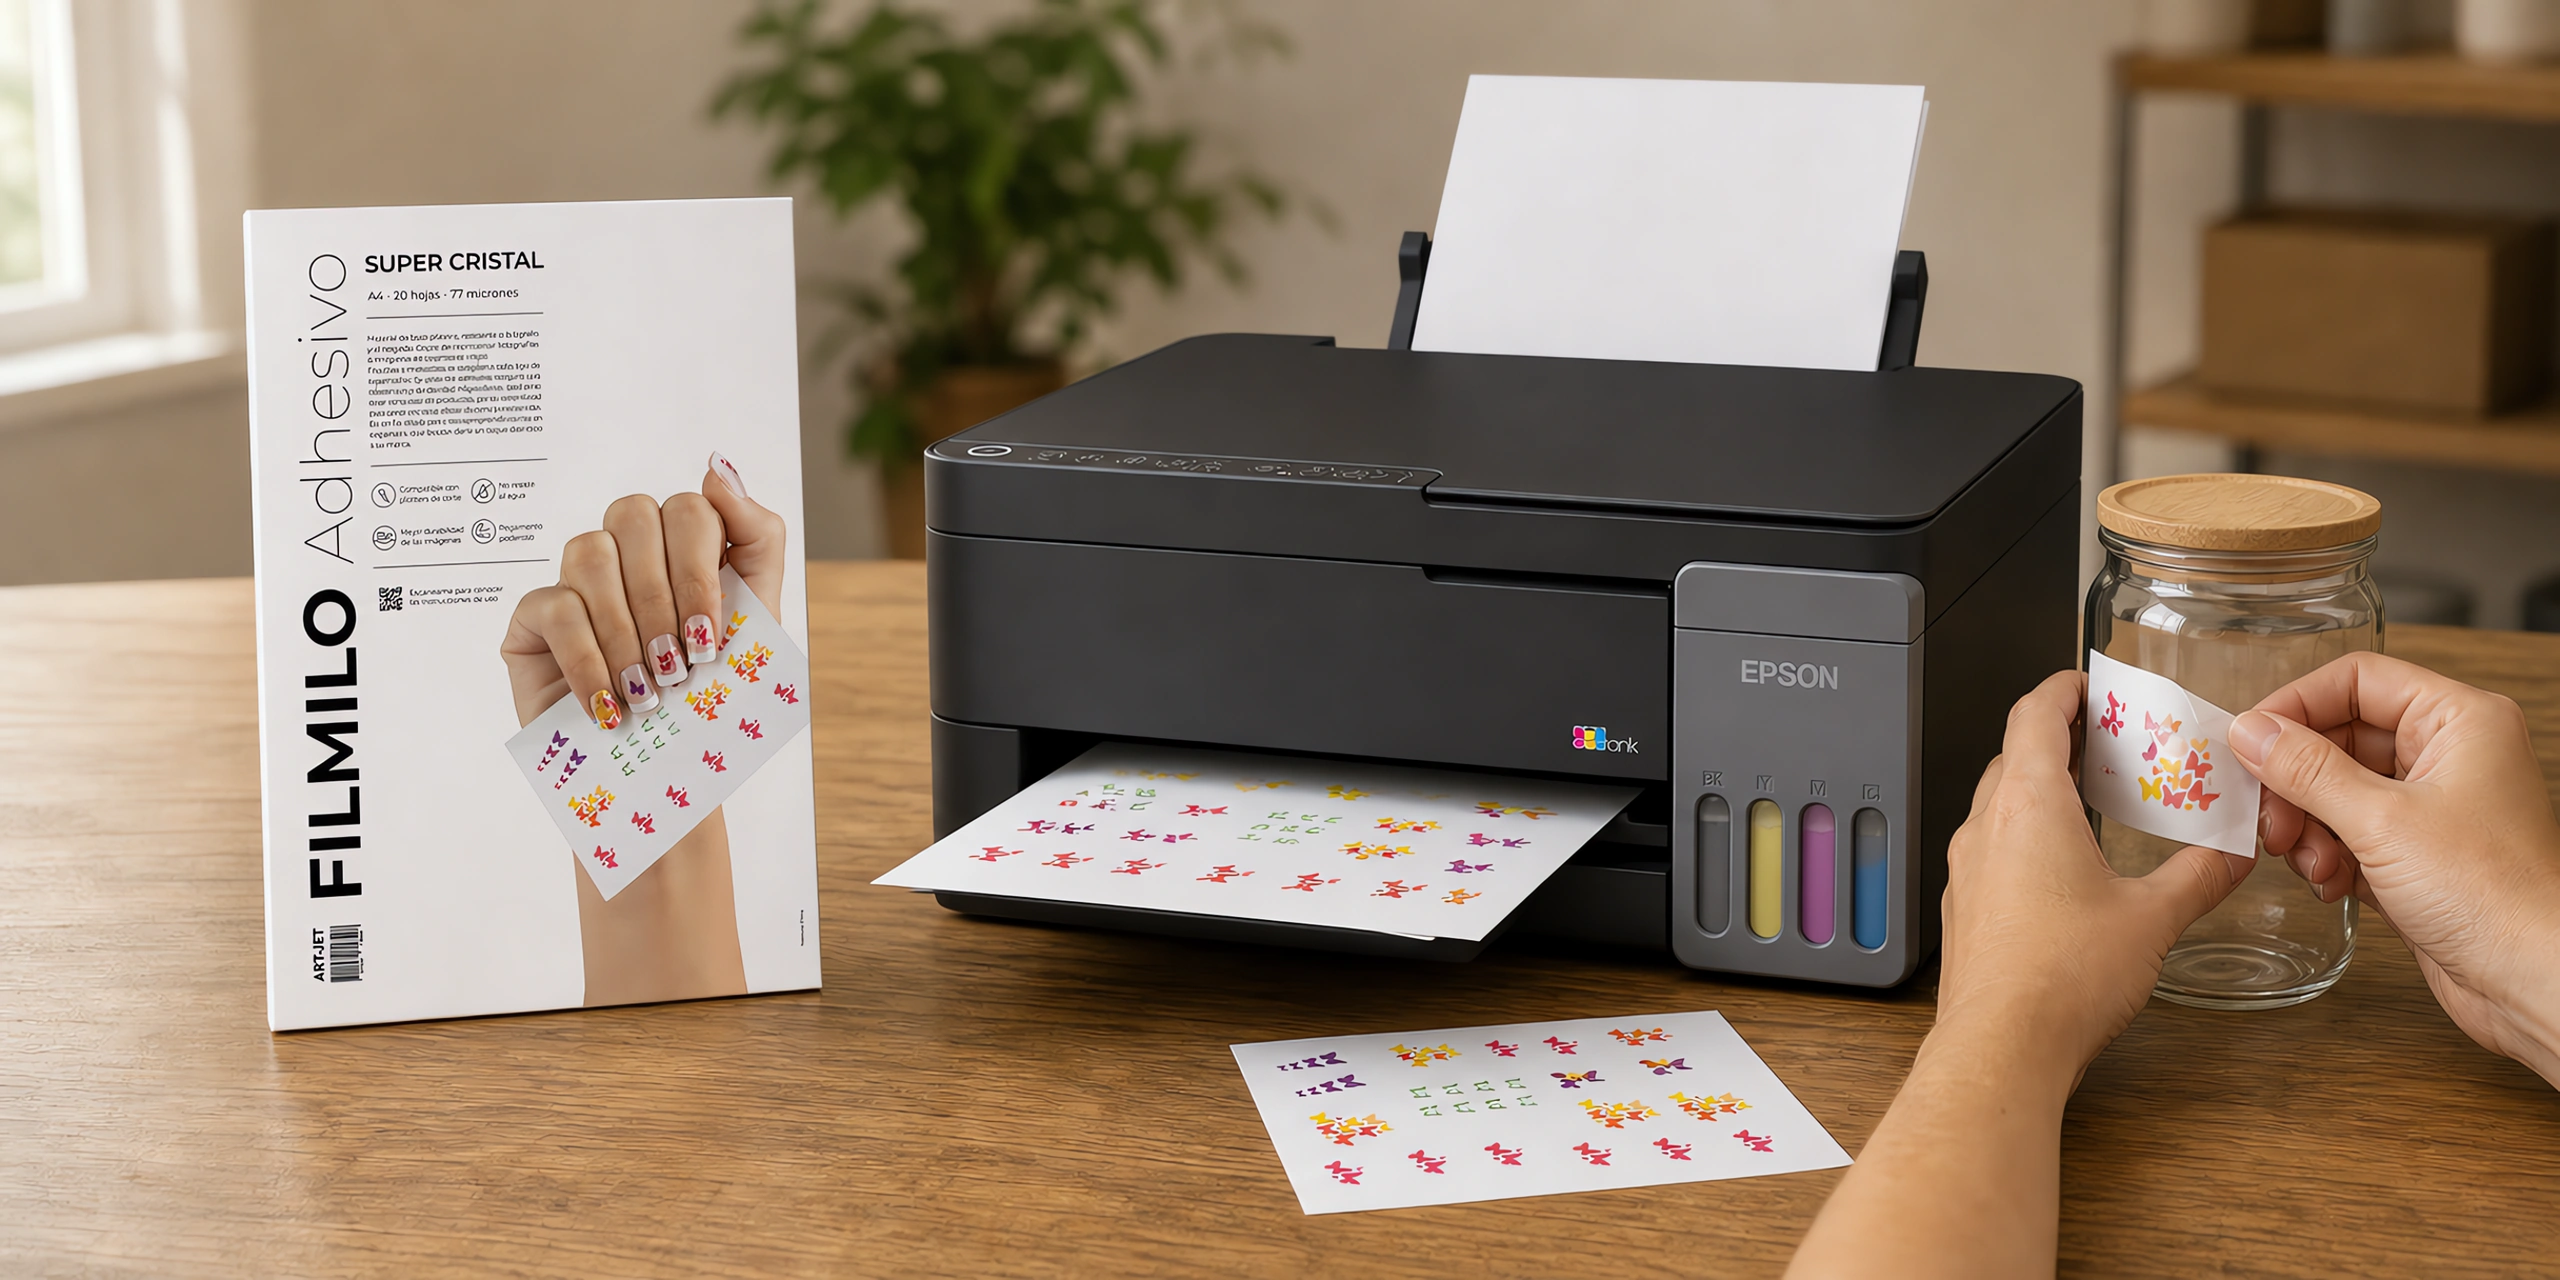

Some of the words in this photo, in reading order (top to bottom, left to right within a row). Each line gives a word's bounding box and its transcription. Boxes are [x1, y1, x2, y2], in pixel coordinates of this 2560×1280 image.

[365, 254, 443, 273] SUPER
[449, 251, 545, 271] CRISTAL
[367, 291, 384, 301] A4
[393, 290, 408, 301] 20
[410, 289, 441, 302] hojas
[449, 288, 464, 299] 77
[466, 288, 519, 299] micrones
[297, 253, 355, 565] Adhesivo
[1740, 659, 1839, 690] EPSON
[302, 588, 363, 899] FILMILO
